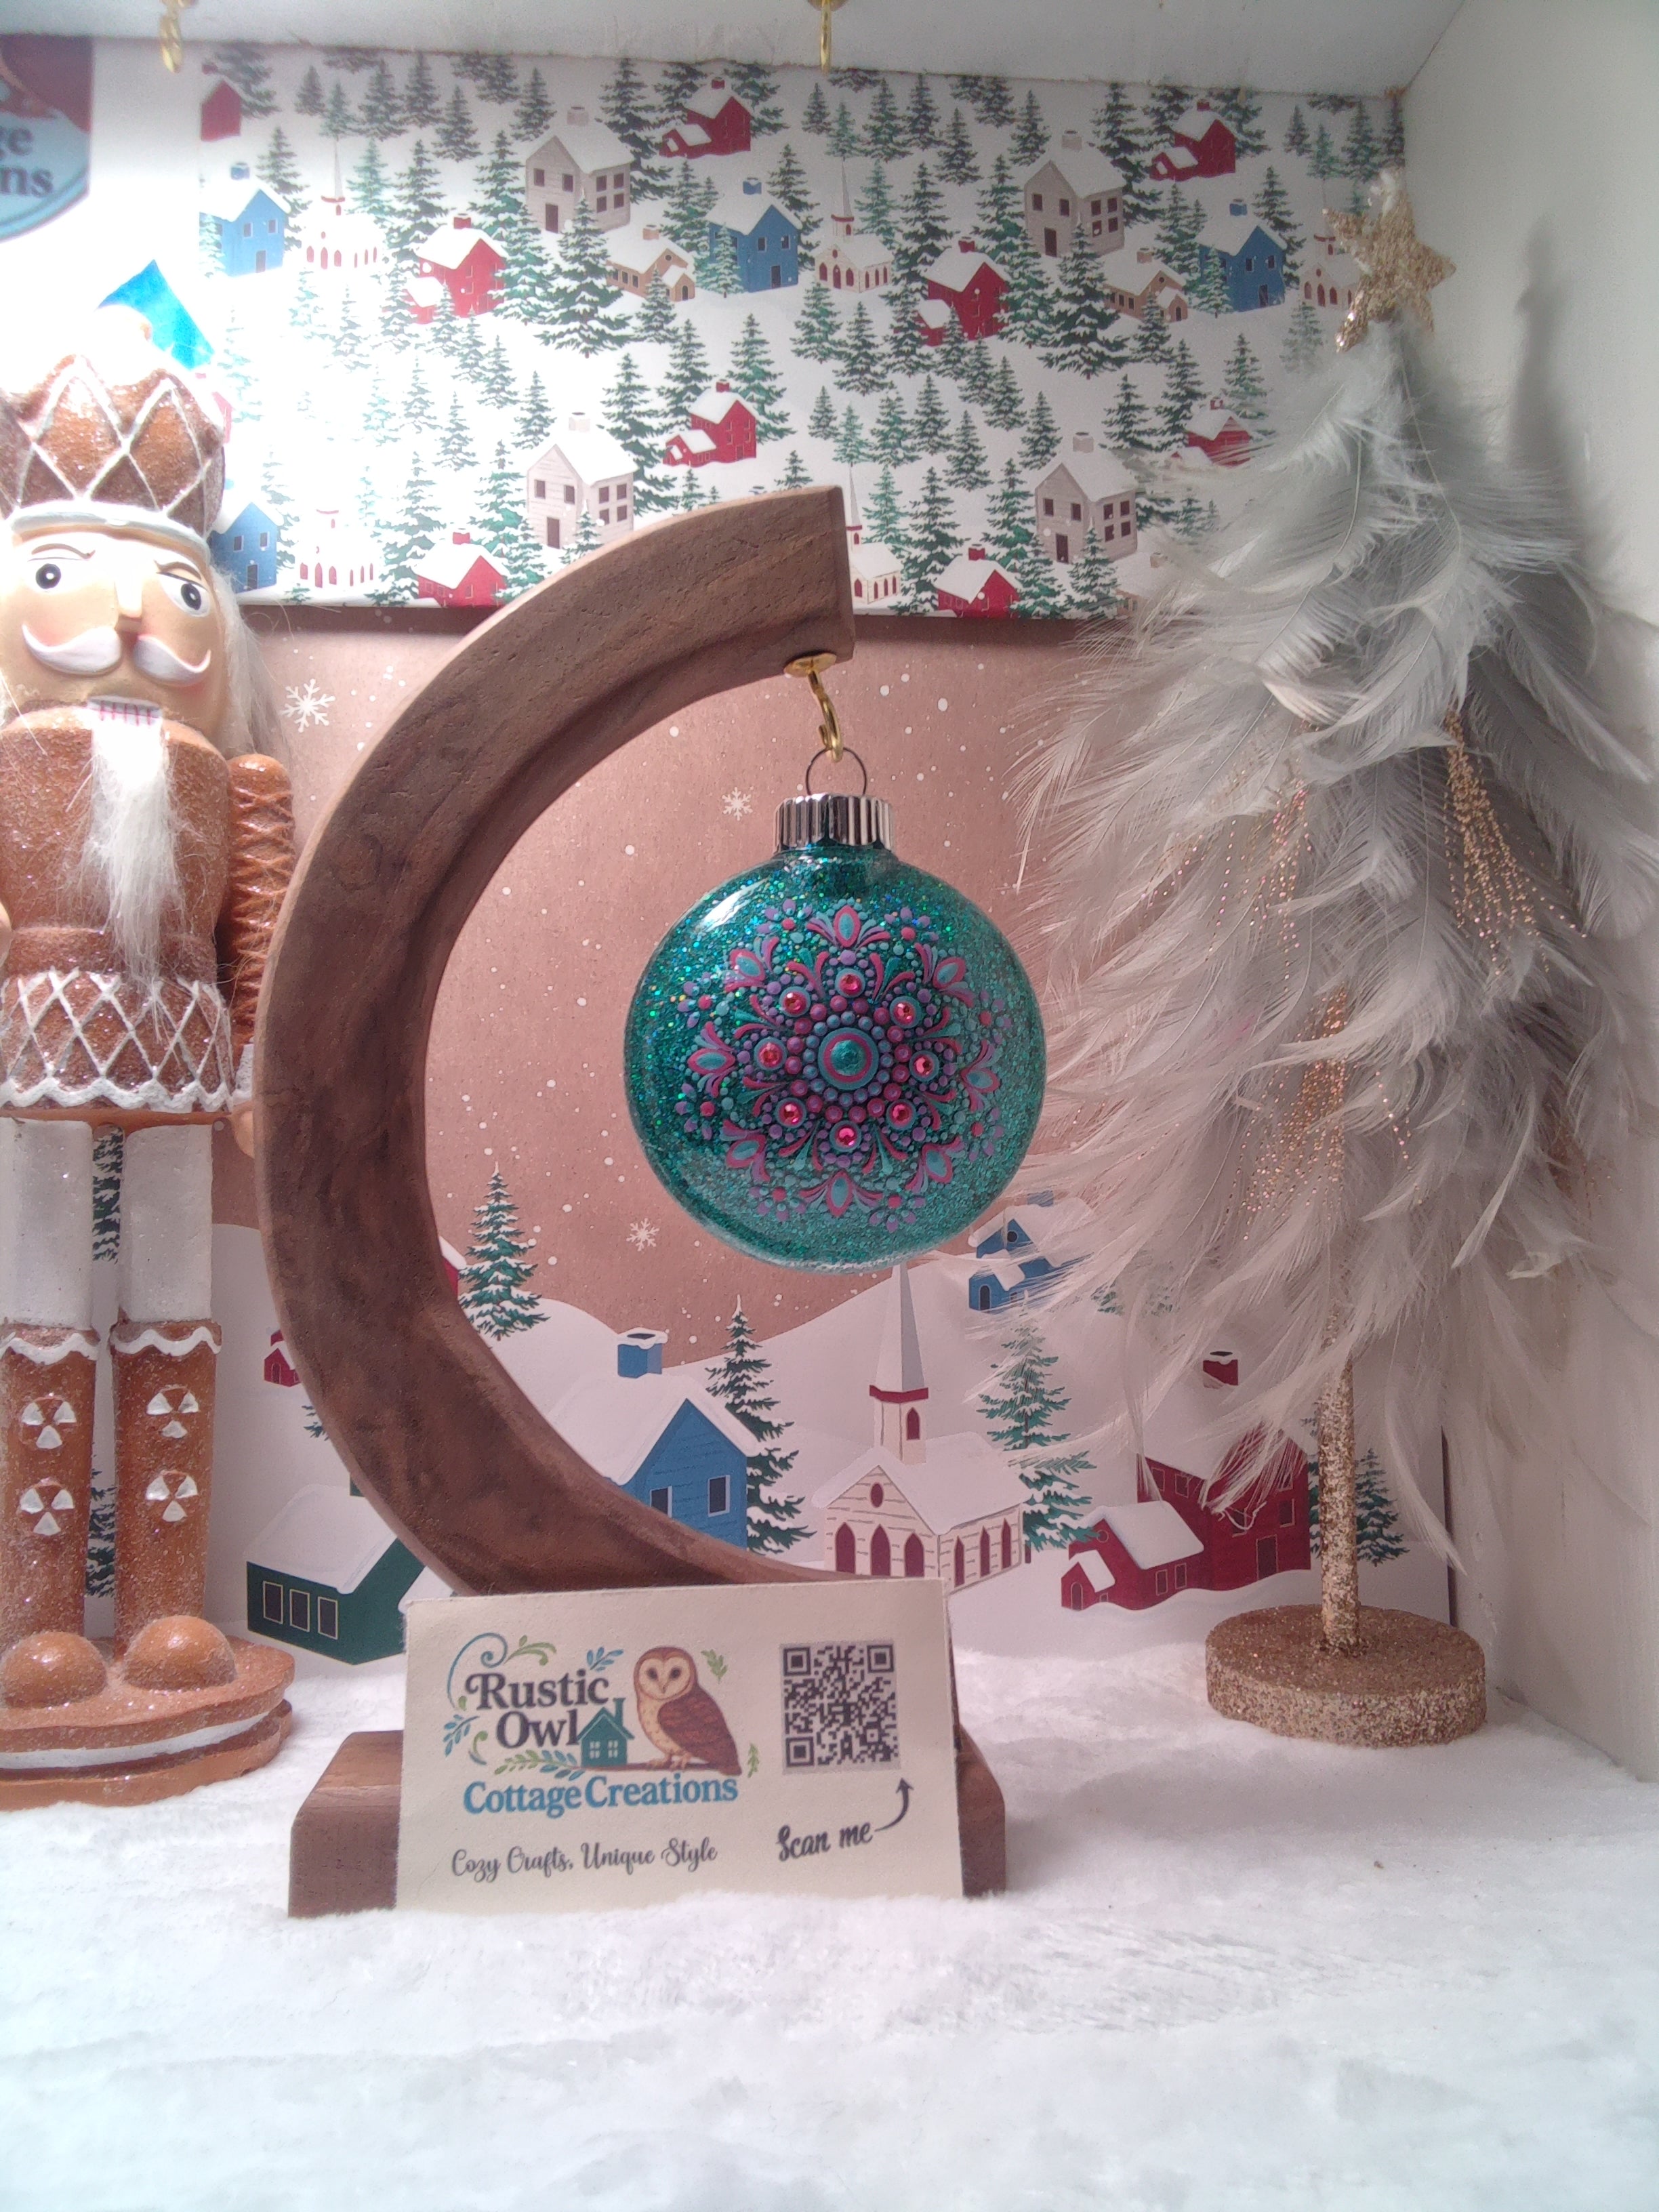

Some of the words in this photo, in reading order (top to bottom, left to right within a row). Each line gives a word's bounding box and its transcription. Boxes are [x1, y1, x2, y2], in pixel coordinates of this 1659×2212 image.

[465, 1668, 609, 1710] Rustic
[495, 1708, 580, 1749] Owl
[464, 1780, 582, 1819] Cottage
[585, 1772, 739, 1808] Creations
[452, 1848, 501, 1883] Cozy
[507, 1845, 574, 1878] Crafts,
[580, 1841, 655, 1875] Unique
[661, 1837, 718, 1872] Style
[776, 1824, 831, 1861] Scan
[839, 1822, 873, 1848] me
